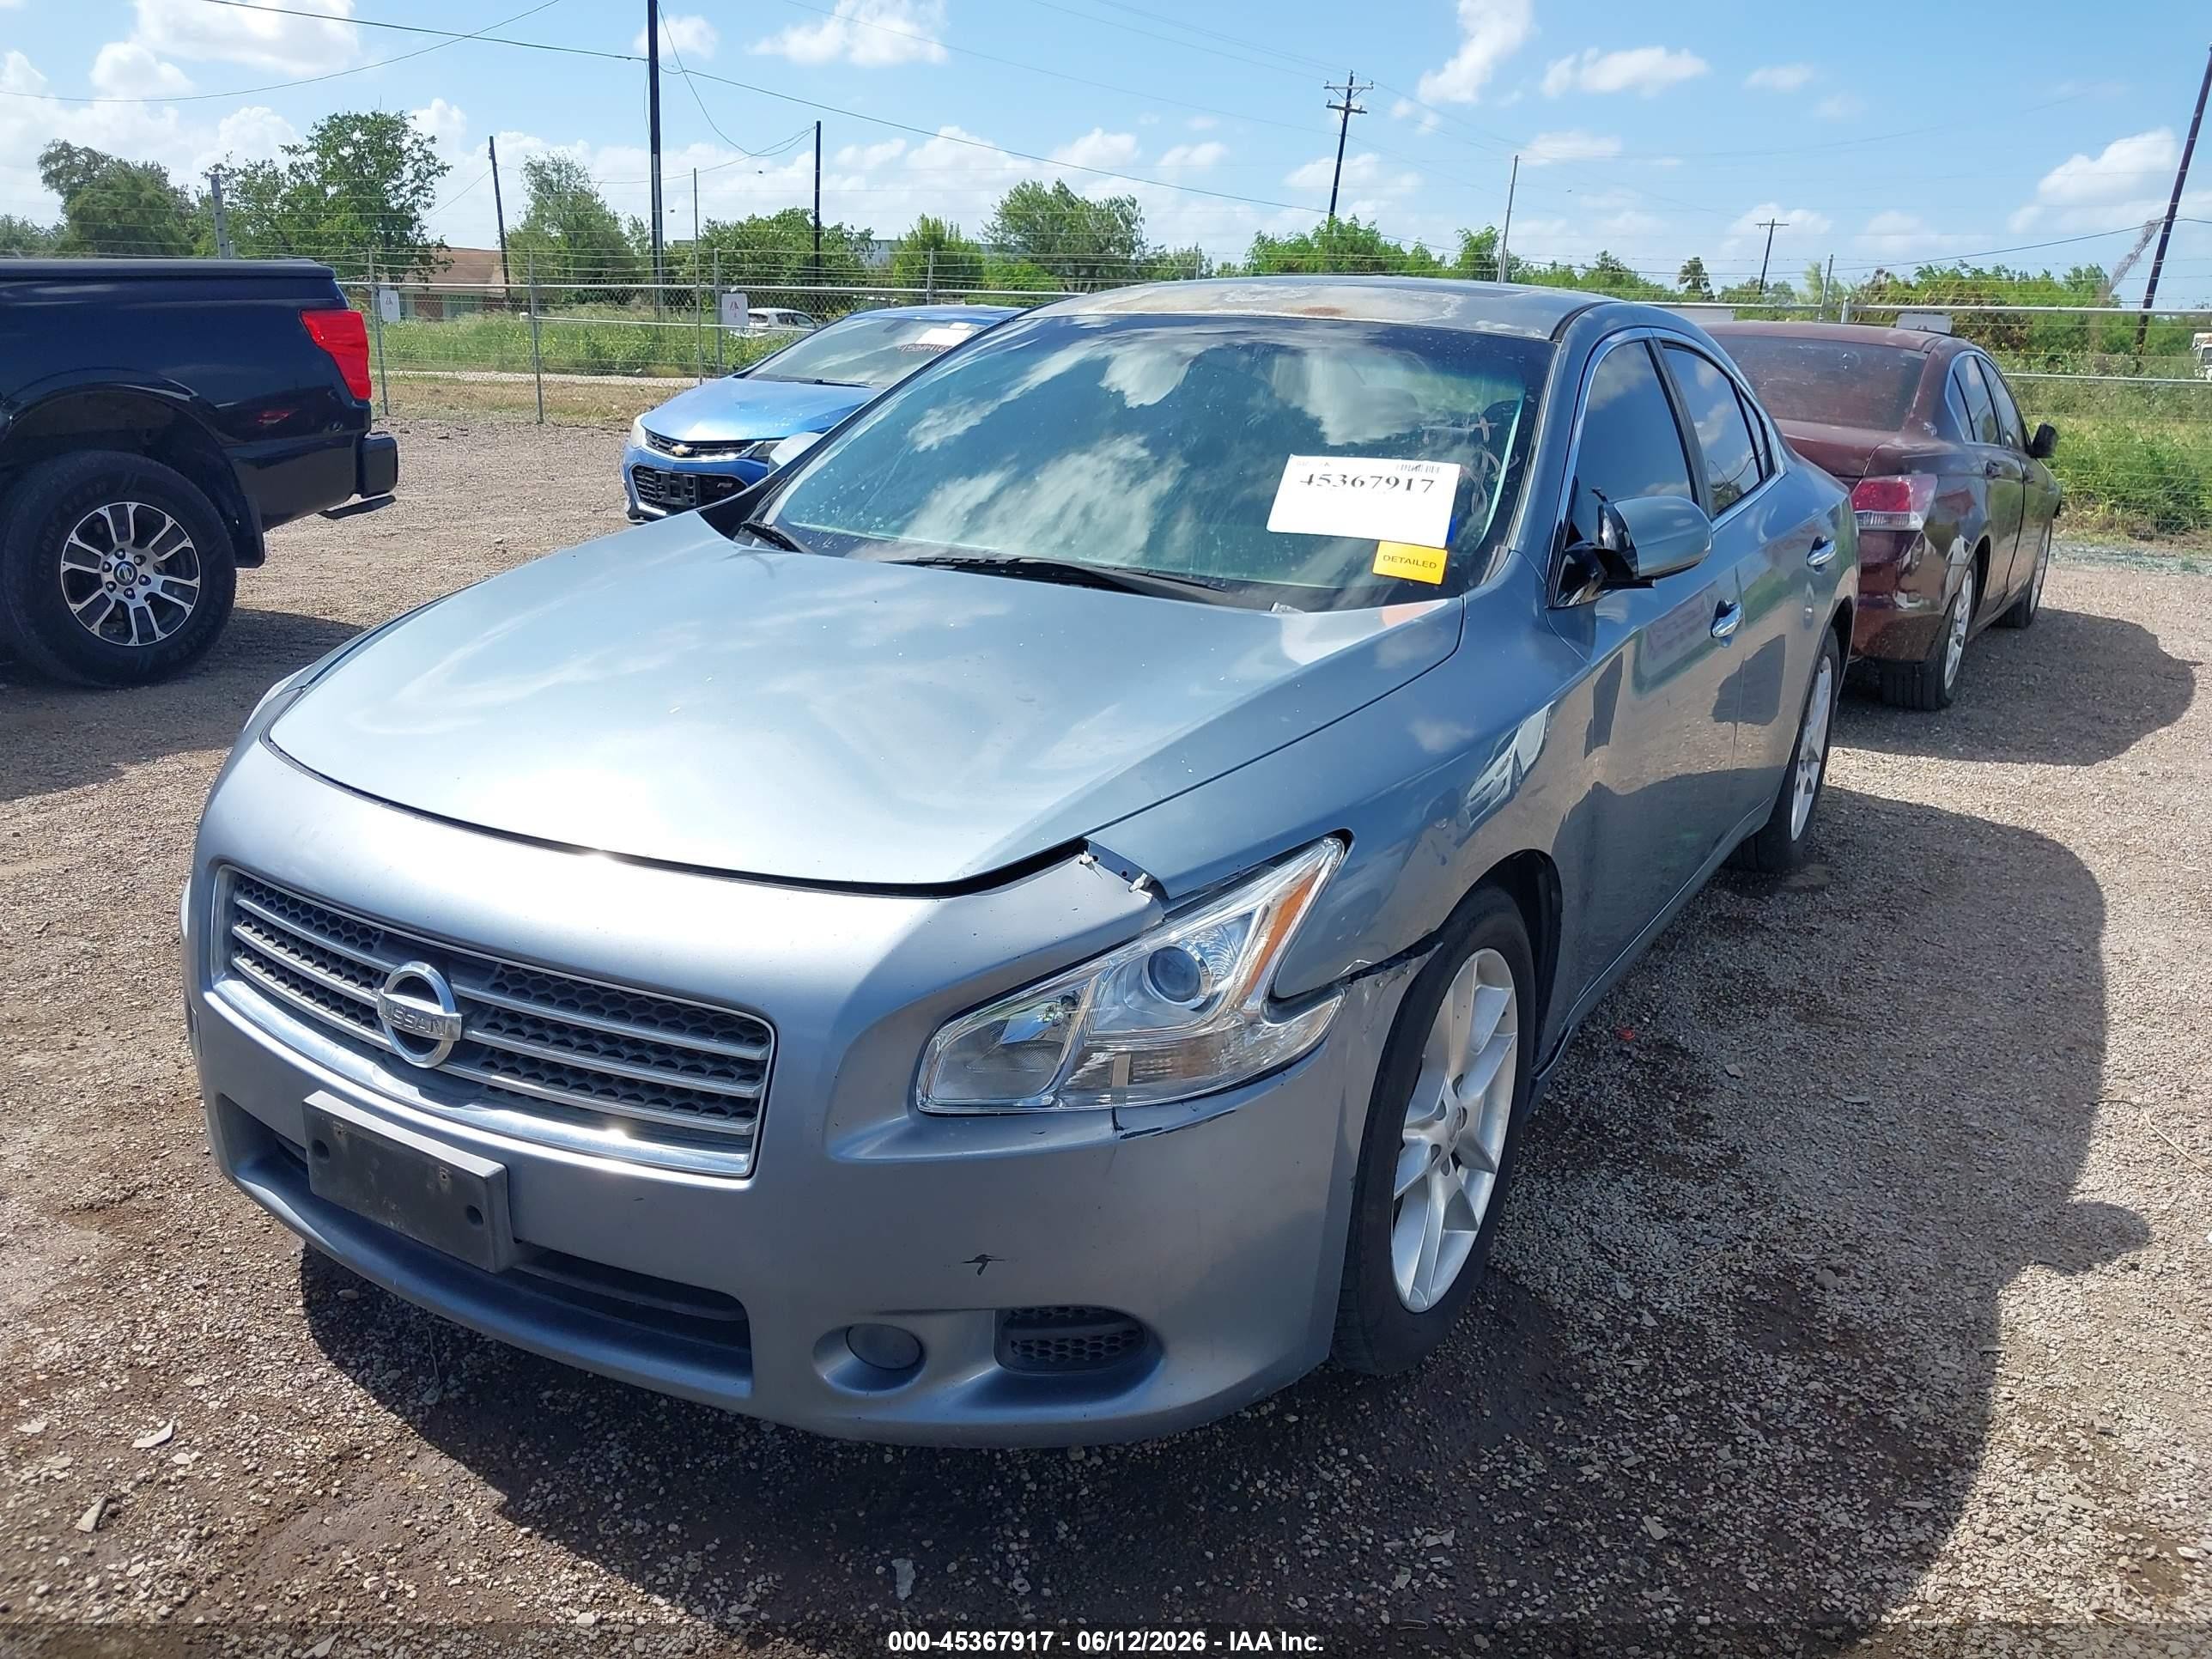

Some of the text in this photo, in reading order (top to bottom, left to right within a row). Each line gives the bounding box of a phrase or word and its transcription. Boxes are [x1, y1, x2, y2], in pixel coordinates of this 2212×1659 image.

[1298, 473, 1436, 494] 45367917
[1382, 554, 1437, 569] DETAILED
[380, 996, 447, 1036] NISSAN
